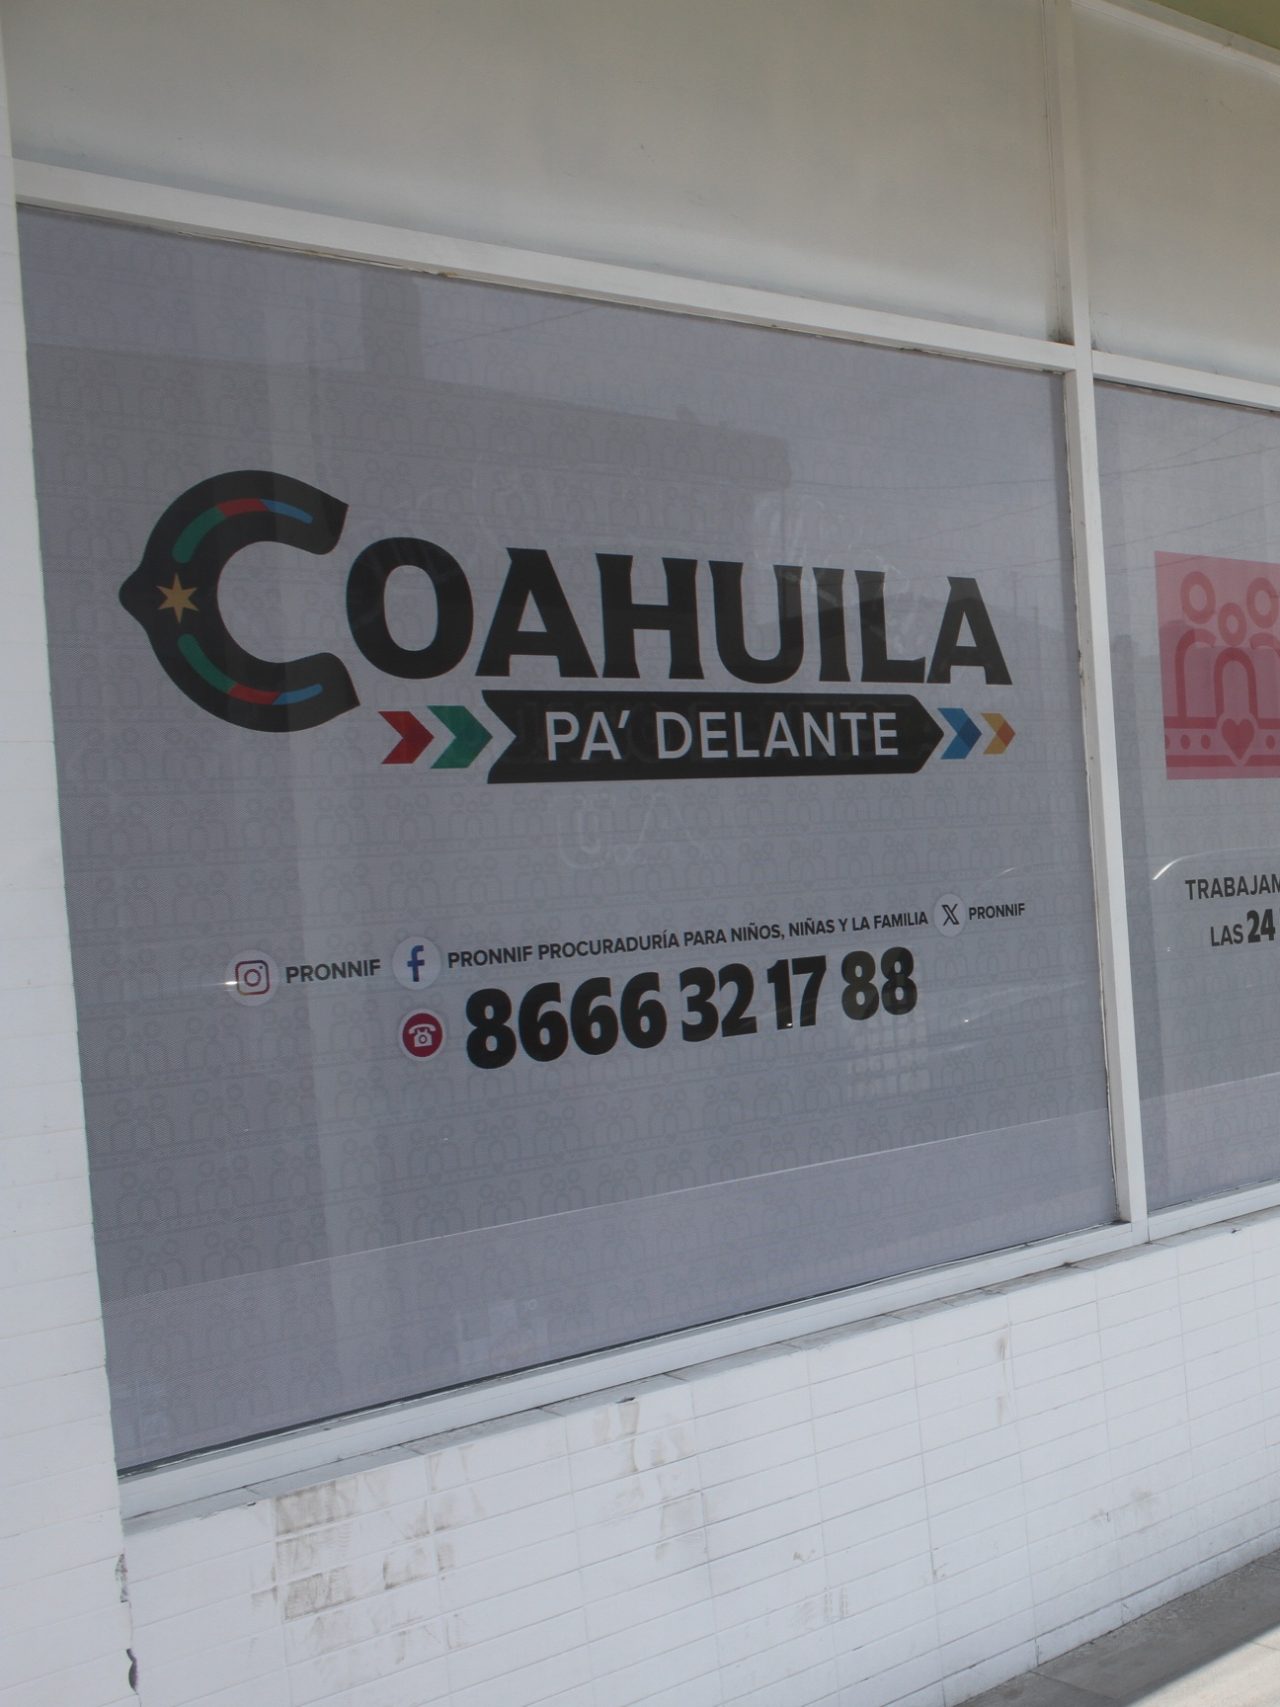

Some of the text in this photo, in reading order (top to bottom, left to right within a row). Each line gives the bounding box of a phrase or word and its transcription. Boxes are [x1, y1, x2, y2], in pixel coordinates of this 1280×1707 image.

[118, 469, 1013, 733] COAHUILA
[656, 710, 899, 760] DELANTE
[968, 902, 1026, 921] PRONNIF
[1210, 923, 1244, 947] LAS
[1246, 909, 1276, 943] 24
[448, 911, 929, 969] PRONNIF PROCURADURÍA PARA NIÑOS, NIÑAS Y LA FAMILIA
[285, 958, 382, 984] PRONNIF
[465, 971, 668, 1070] 8666
[841, 946, 918, 1021] 88
